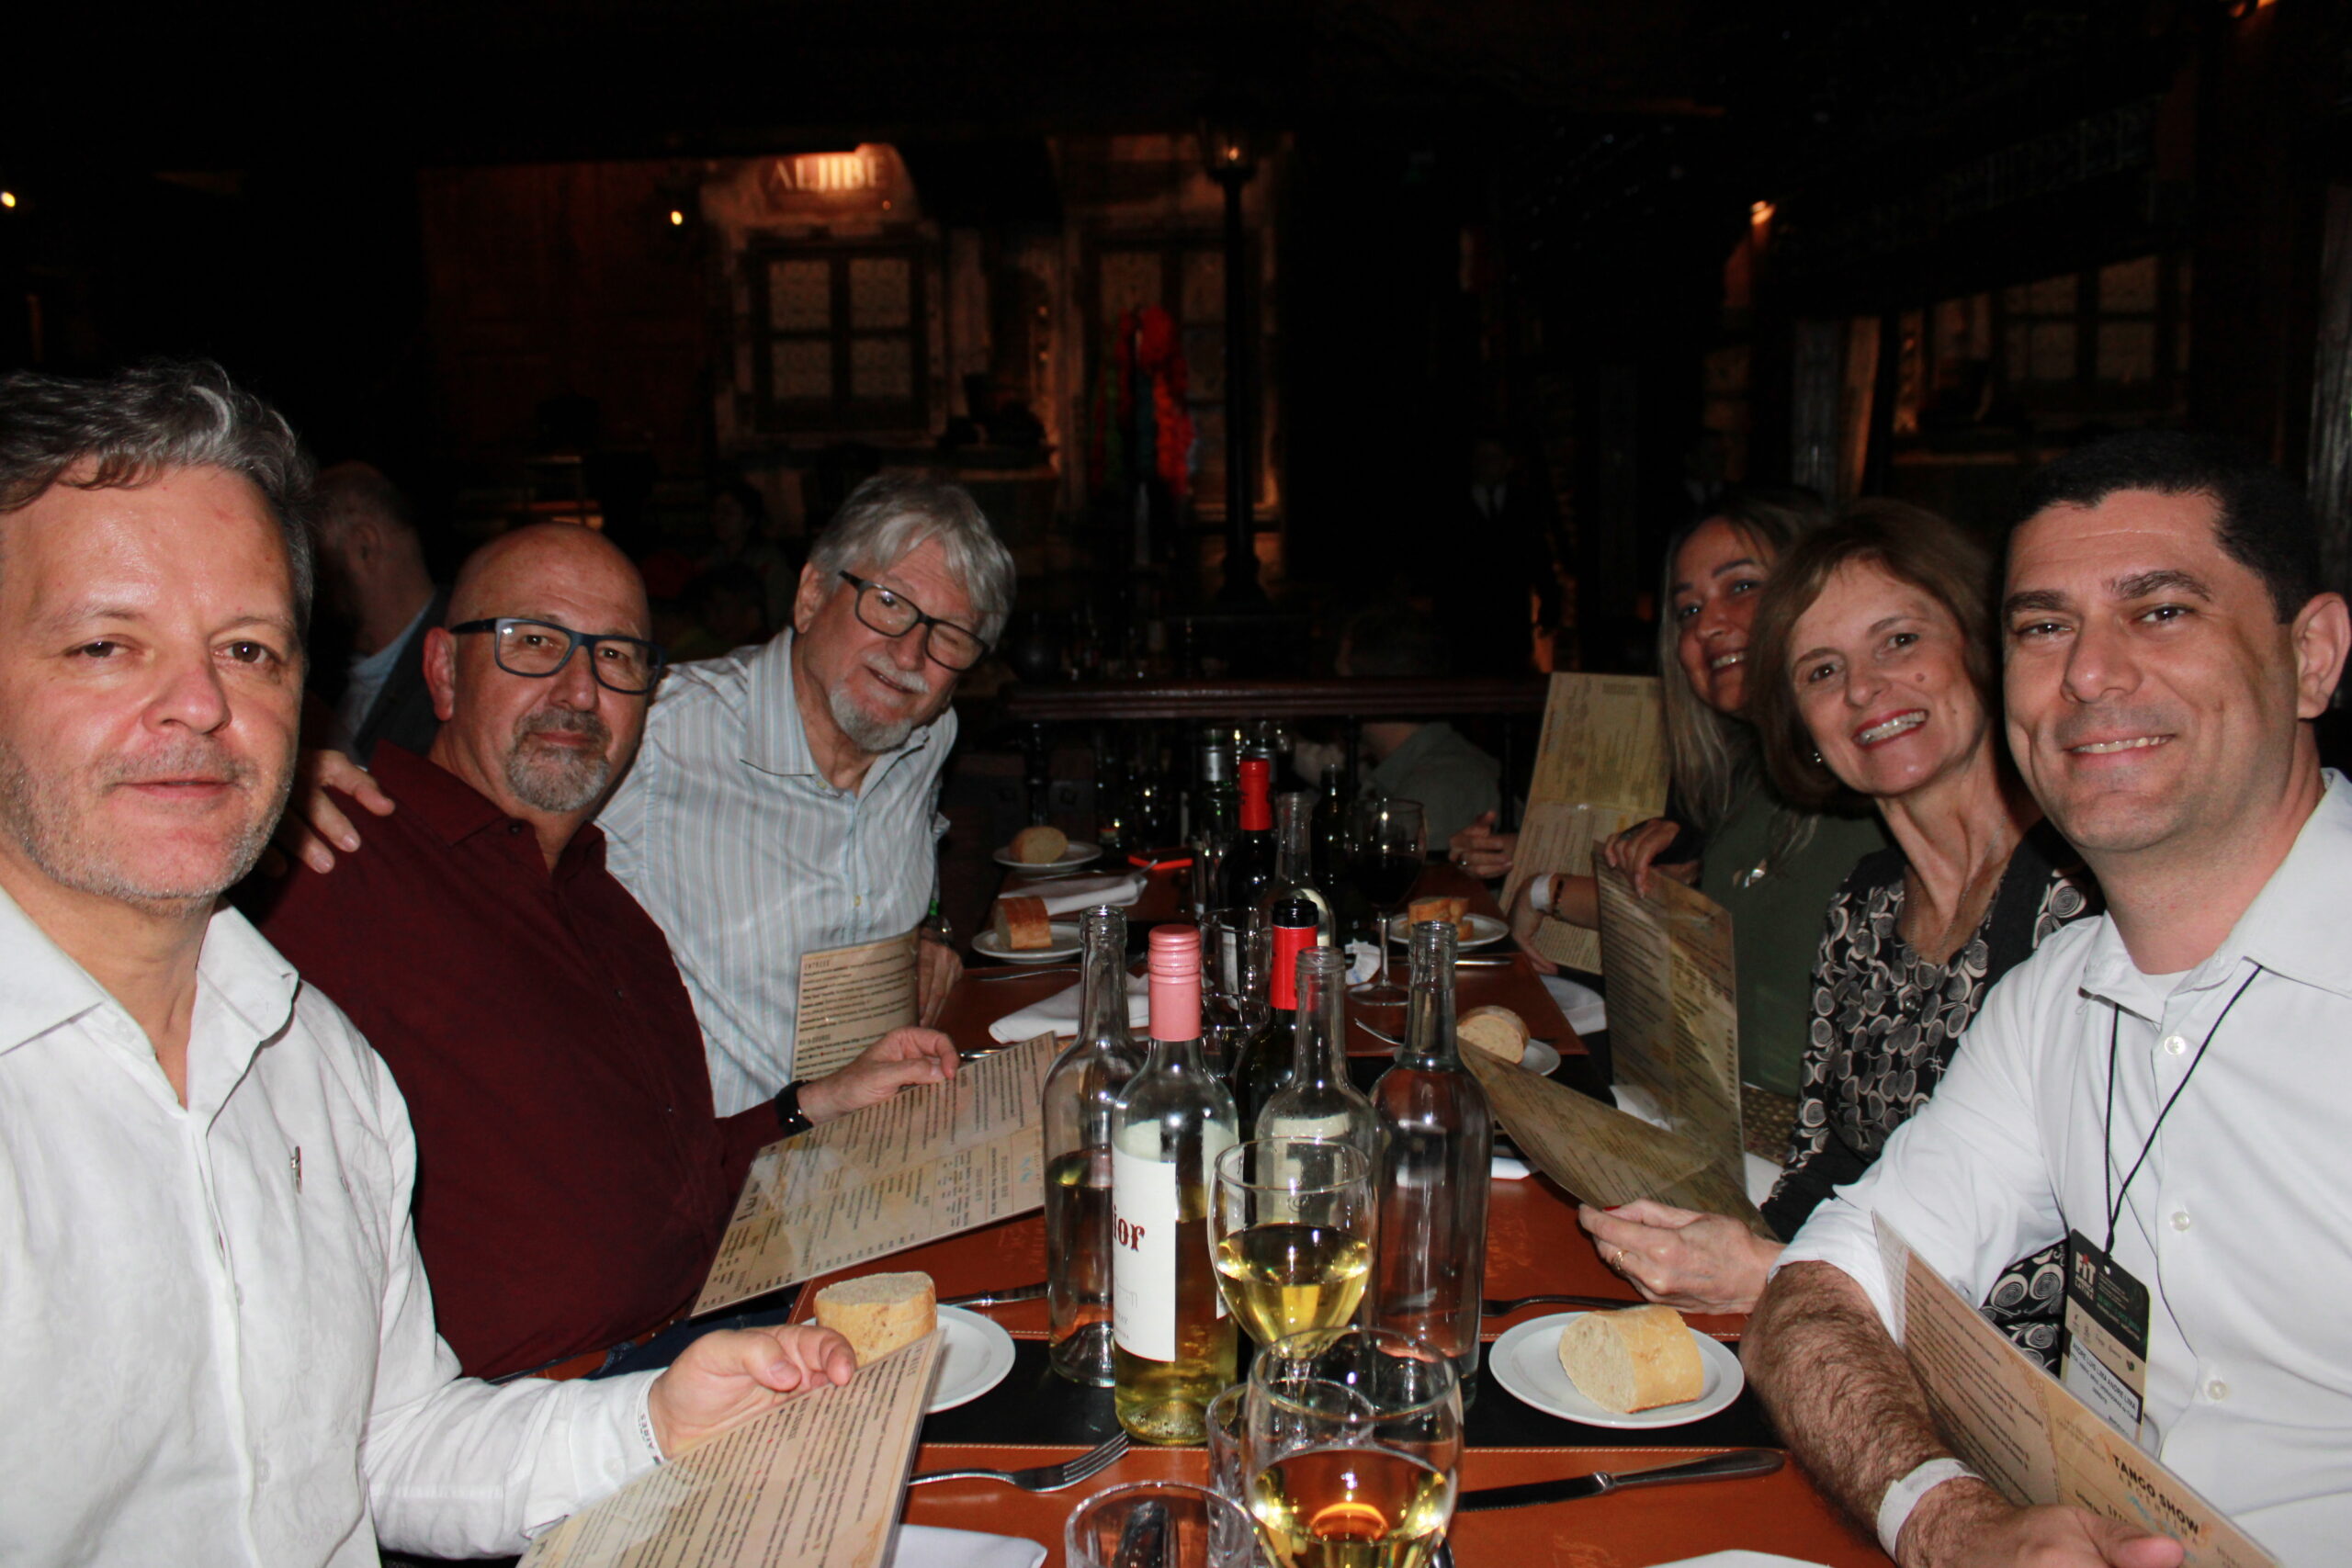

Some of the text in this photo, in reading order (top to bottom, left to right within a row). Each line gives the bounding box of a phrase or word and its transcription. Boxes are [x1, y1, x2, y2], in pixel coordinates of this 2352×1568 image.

[2113, 1454, 2156, 1498] TANGO
[2158, 1493, 2199, 1535] SHOW
[2118, 1472, 2199, 1544] ARGENTINA
